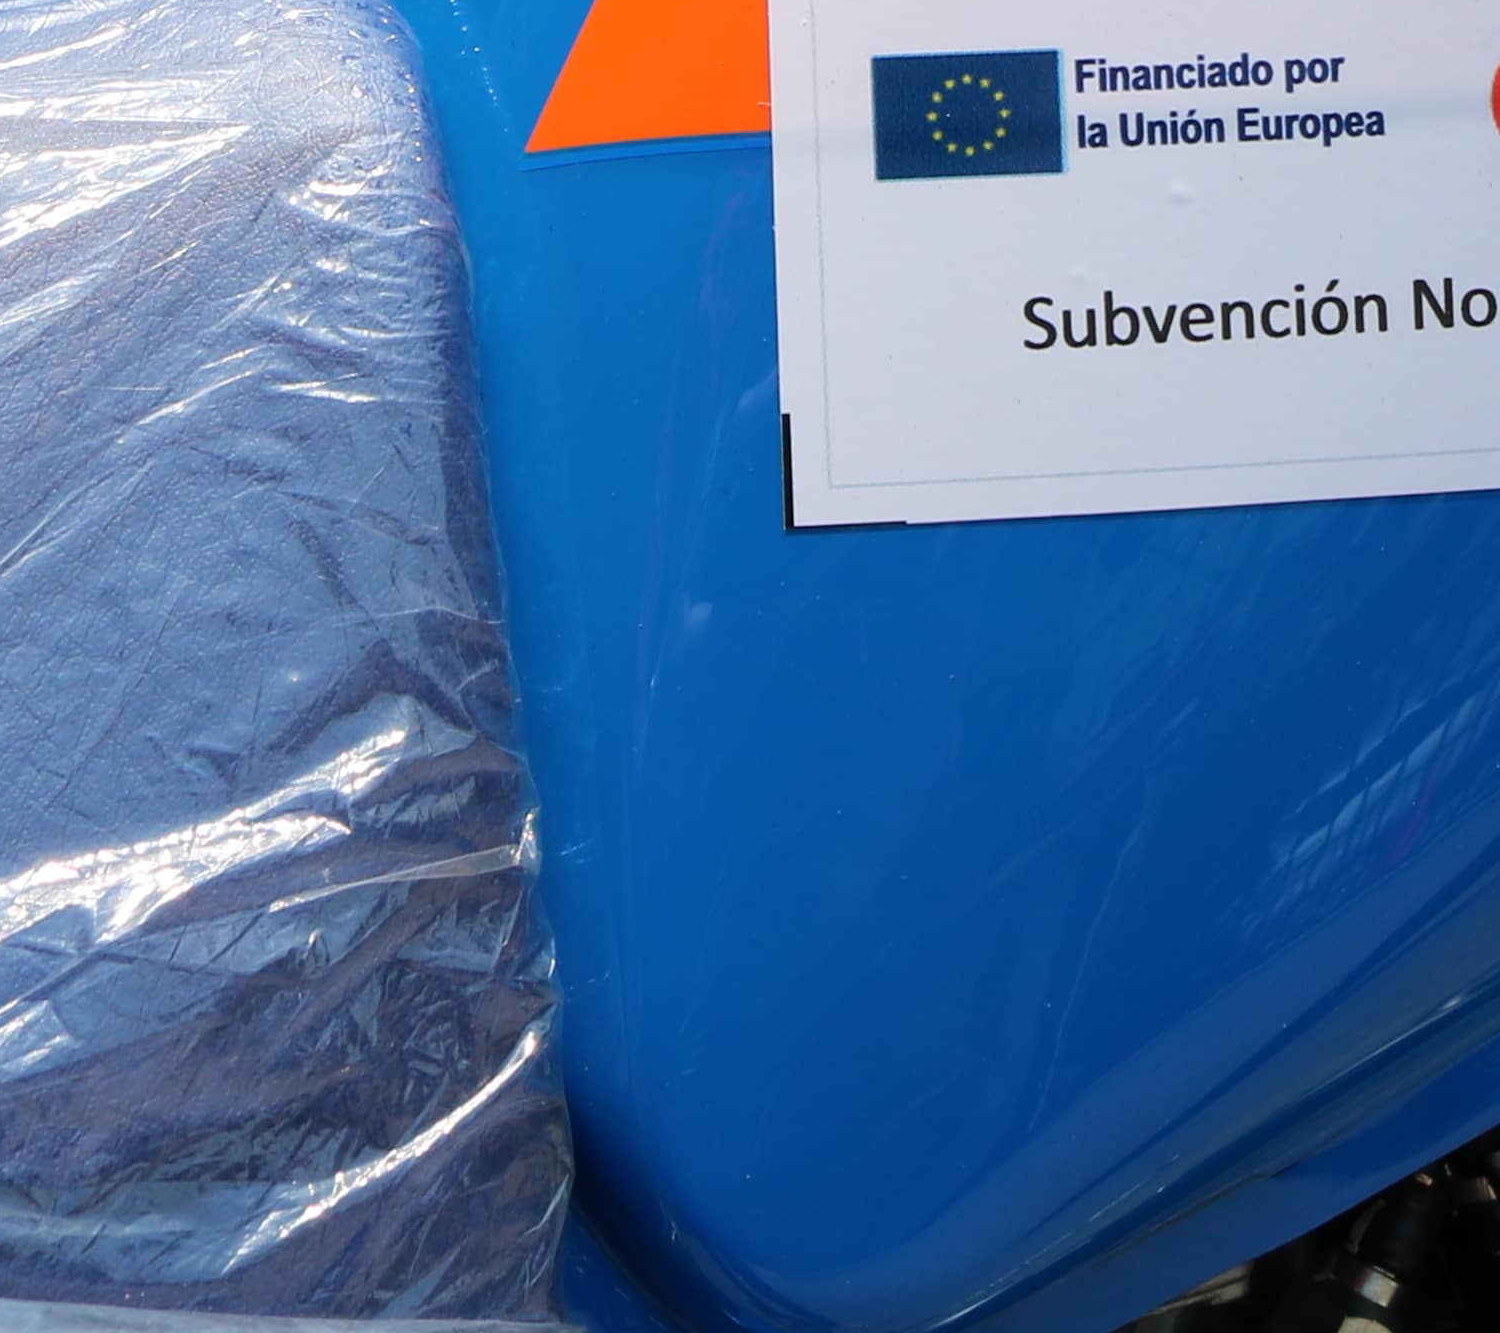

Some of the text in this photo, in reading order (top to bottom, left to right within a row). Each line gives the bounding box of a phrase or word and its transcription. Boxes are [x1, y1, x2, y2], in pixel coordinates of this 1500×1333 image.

[1074, 52, 1346, 94] Financiado por
[1076, 106, 1386, 149] la Unión Europea
[1023, 278, 1389, 351] Subvención
